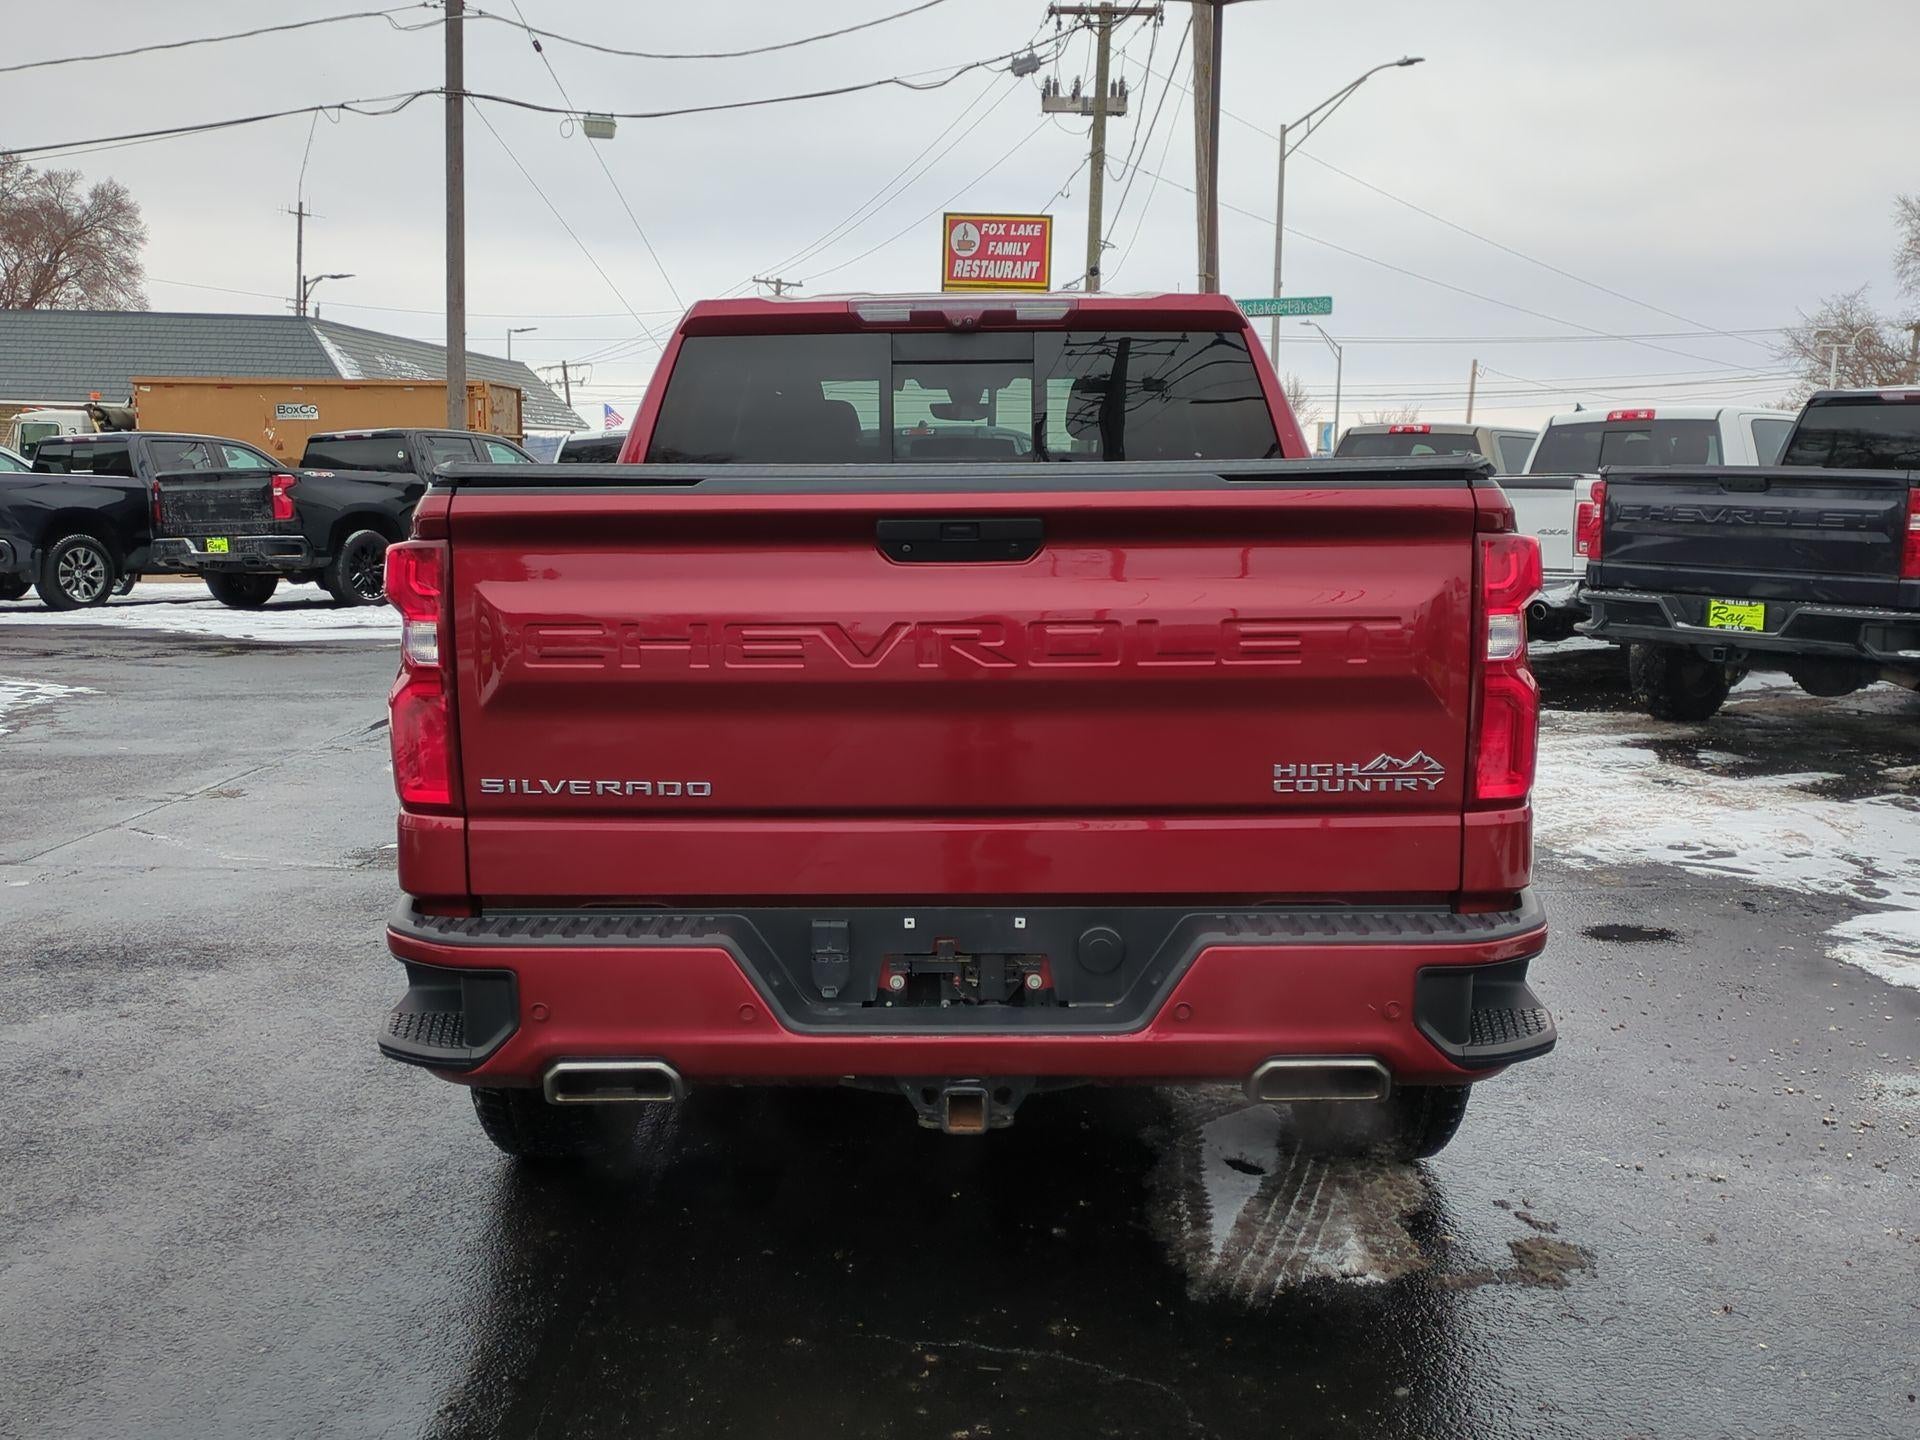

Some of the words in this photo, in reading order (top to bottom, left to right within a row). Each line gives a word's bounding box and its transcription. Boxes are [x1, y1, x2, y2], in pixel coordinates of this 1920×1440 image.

[981, 223, 1006, 235] FOX
[1010, 224, 1042, 236] LAKE
[987, 241, 1030, 255] FAMILY
[953, 260, 1040, 279] RESTAURANT
[1288, 300, 1313, 314] Lake
[277, 405, 316, 414] BoxCo
[1619, 504, 1880, 528] CHEVROLET
[1711, 605, 1745, 626] Ray
[523, 617, 1402, 669] CHEVROLET
[1273, 763, 1360, 777] HIGH
[480, 778, 712, 796] SILVERADO
[1273, 777, 1444, 792] COUNTRY
